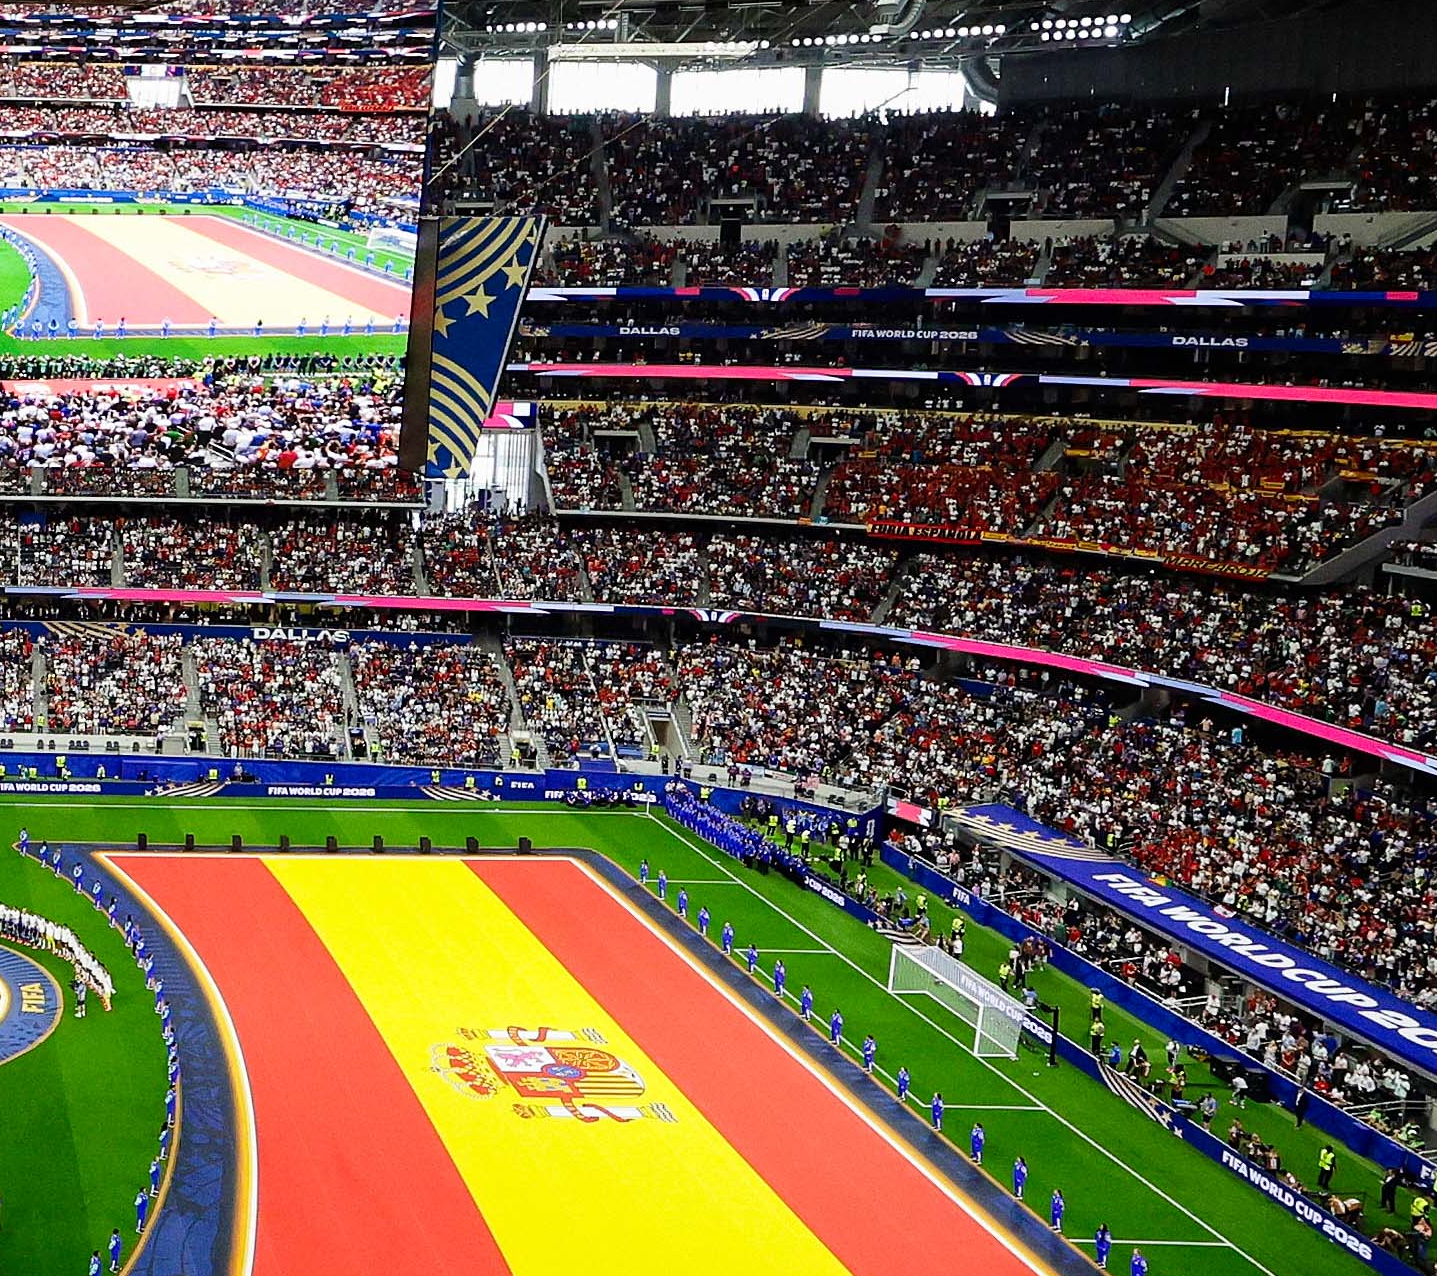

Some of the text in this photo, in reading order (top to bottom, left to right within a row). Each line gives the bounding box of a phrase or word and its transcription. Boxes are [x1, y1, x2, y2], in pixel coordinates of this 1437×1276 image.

[619, 326, 680, 336] DALLAS
[851, 329, 979, 340] FIFA WORLD CUP 2026
[1172, 336, 1249, 347] DALLAS
[253, 628, 350, 642] DALLAS
[16, 783, 49, 791] WORLD
[49, 783, 69, 792] CUP
[69, 783, 101, 792] 2026
[268, 786, 376, 796] FIFA WORLD CUP 2026
[510, 781, 535, 789] FIFA
[822, 886, 845, 906] 2026
[953, 886, 970, 905] FIFA
[1092, 873, 1173, 908] FIFA
[1159, 905, 1296, 969] WORLD
[1281, 968, 1379, 1010] CUP
[21, 982, 46, 1014] FIFA
[1222, 1150, 1373, 1261] FIFA WORLD CUP 2026
